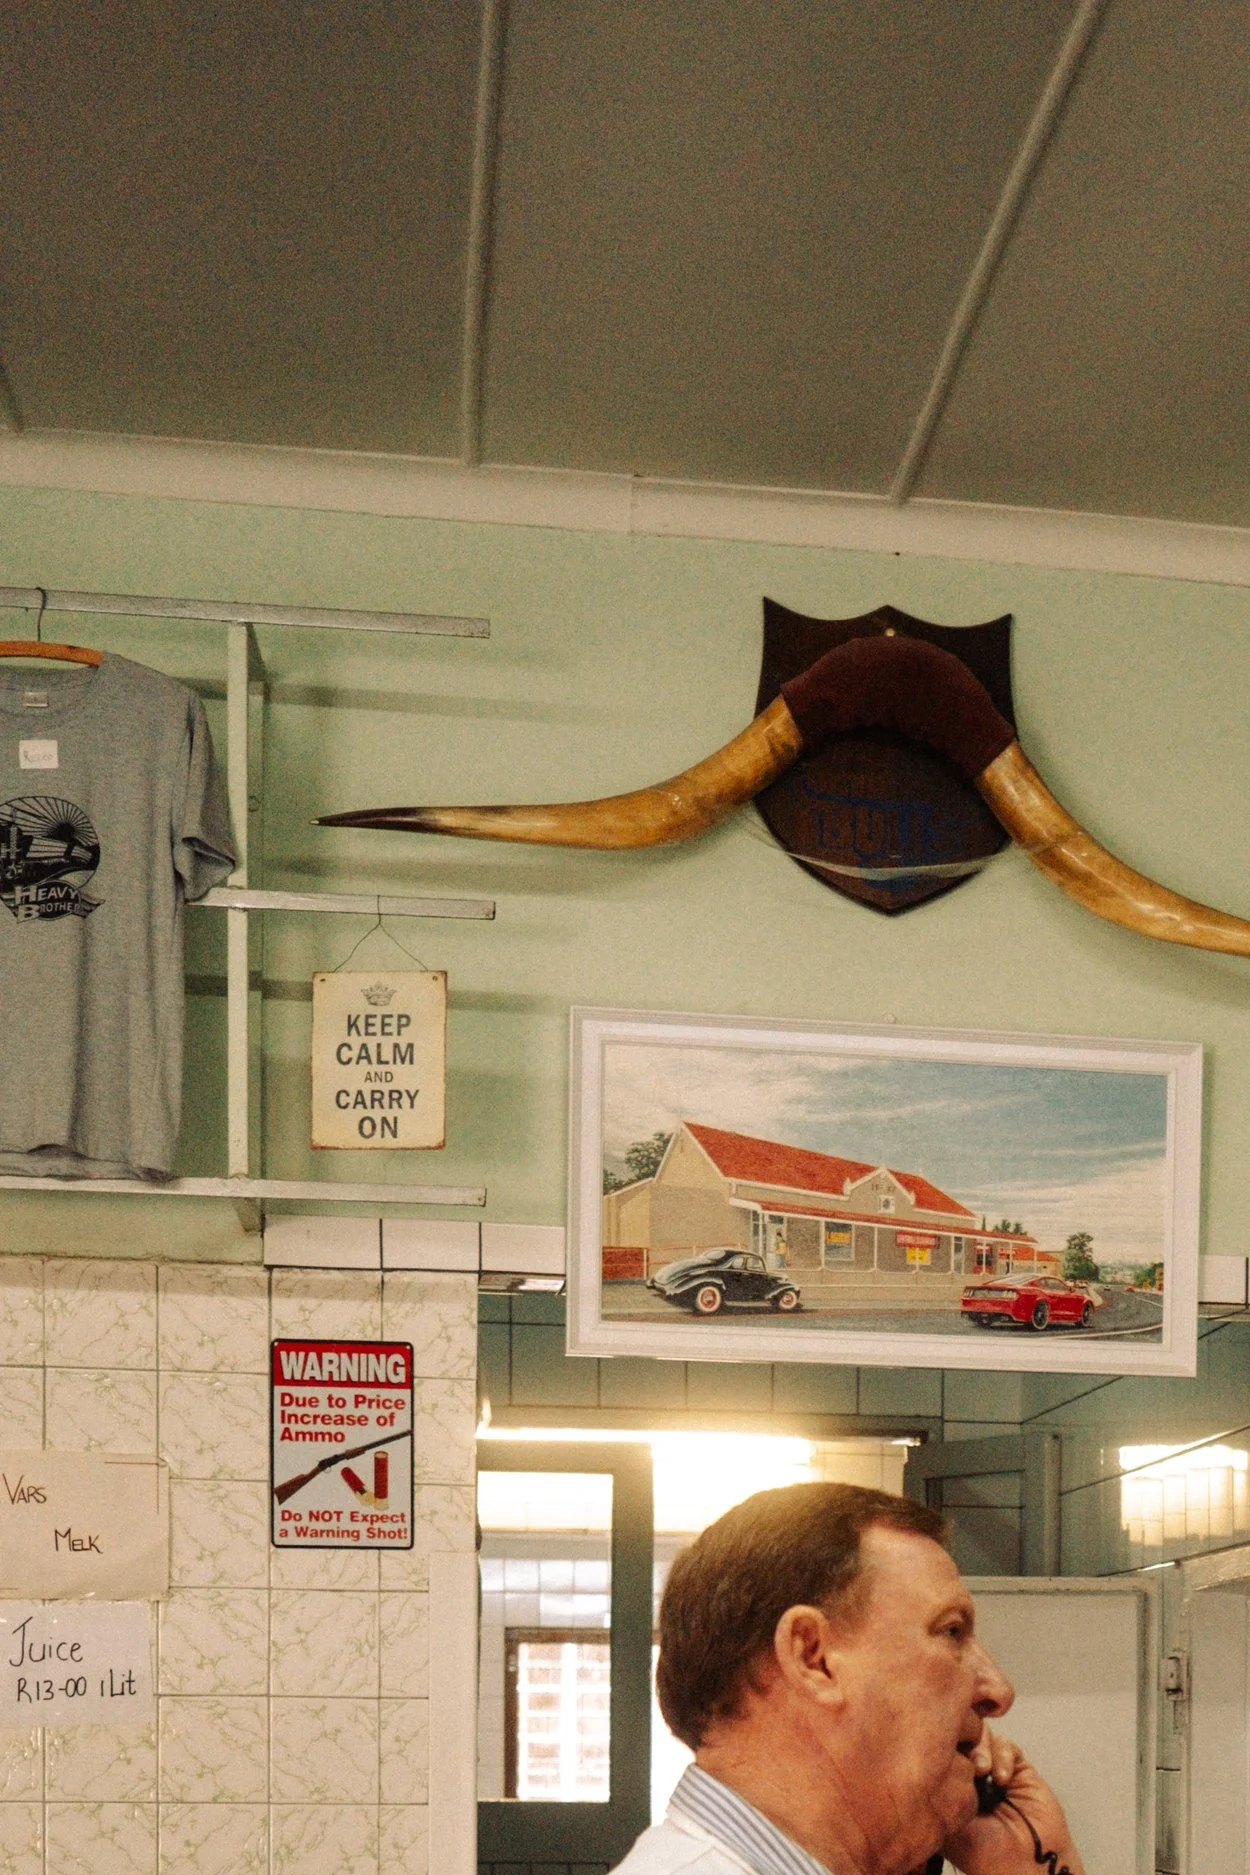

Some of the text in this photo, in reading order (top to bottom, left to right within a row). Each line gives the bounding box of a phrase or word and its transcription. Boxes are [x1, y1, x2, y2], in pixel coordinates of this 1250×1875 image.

[14, 885, 79, 904] HEAVY
[347, 1014, 412, 1037] KEEP
[336, 1042, 415, 1066] CALM
[364, 1071, 394, 1083] AND
[335, 1089, 419, 1110] CARRY
[358, 1116, 398, 1139] ON
[279, 1350, 406, 1384] WARNING
[280, 1392, 406, 1410] Due to Price
[280, 1410, 395, 1427] Increase of
[279, 1427, 345, 1443] Ammo
[2, 1473, 47, 1505] VARS
[281, 1509, 406, 1525] Do NOT Expect
[279, 1526, 408, 1542] a Warning Shot!
[9, 1616, 84, 1667] Juice
